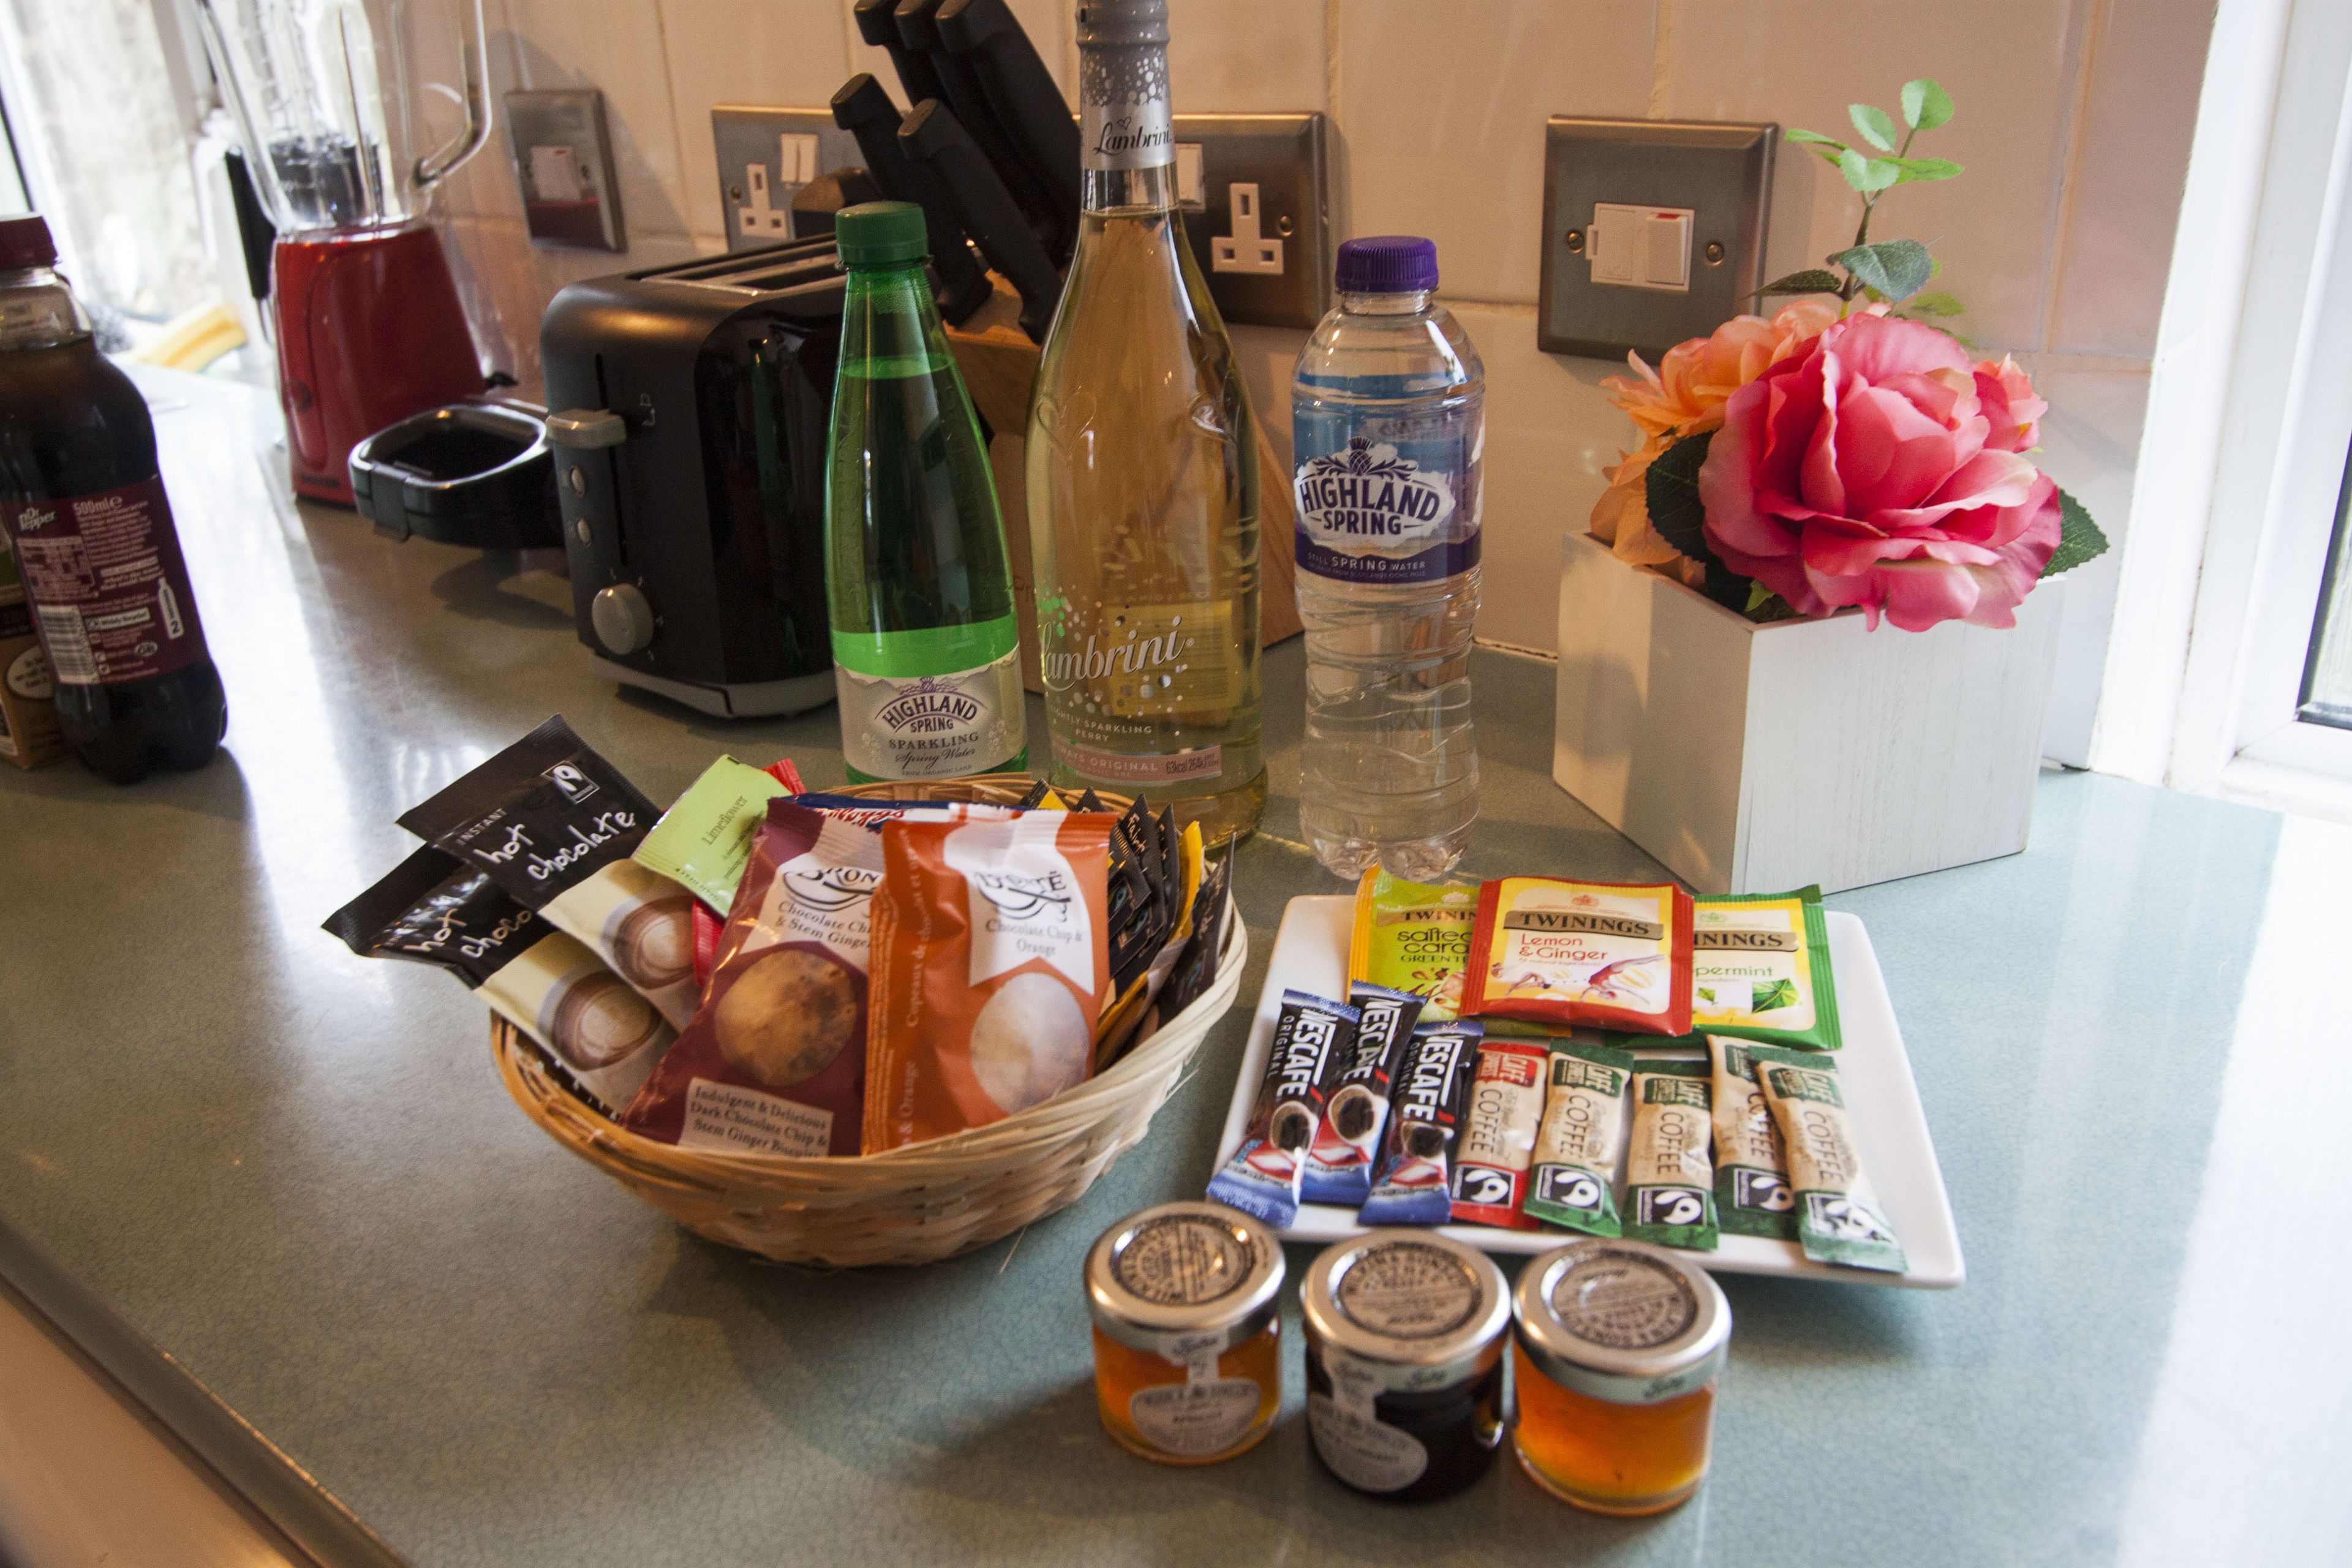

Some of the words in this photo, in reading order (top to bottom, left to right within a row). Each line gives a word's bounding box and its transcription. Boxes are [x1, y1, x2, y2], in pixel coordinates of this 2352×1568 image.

[1093, 122, 1170, 156] Lambrini
[1299, 477, 1441, 521] HIGHLAND
[1323, 510, 1402, 535] SPRING
[1332, 556, 1387, 571] SPRING
[1390, 561, 1426, 571] WATER
[882, 695, 979, 729] HIGHLAND
[911, 717, 954, 734] SPRING
[889, 731, 979, 750] SPARKLING
[1076, 728, 1109, 742] PERRY
[1085, 720, 1153, 734] SPARKLING
[895, 751, 946, 770] Spring
[943, 747, 976, 761] Water
[1090, 757, 1158, 772] ORIGINAL
[456, 807, 507, 846] INSTANT
[701, 795, 748, 846] Limeflower
[473, 823, 533, 864] hot
[527, 811, 636, 880] chocolate
[778, 900, 843, 929] Chocolate
[1520, 913, 1649, 935] TWININGS
[402, 908, 467, 952] hot
[787, 919, 823, 940] Stem
[1047, 925, 1072, 944] Chip
[1521, 933, 1583, 946] Lemon
[1694, 933, 1782, 947] ININGS
[1017, 938, 1056, 956] Orange
[1518, 947, 1533, 957] &
[1537, 946, 1608, 961] Ginger
[1695, 966, 1774, 977] permint
[1265, 1015, 1295, 1079] ORIGINAL
[1500, 1054, 1529, 1085] CAFÉ
[1585, 1065, 1615, 1093] CAFÉ
[694, 1086, 756, 1108] Indulgent
[770, 1104, 826, 1130] Delicious
[1471, 1088, 1502, 1153] COFFEE
[690, 1102, 720, 1118] Dark
[725, 1107, 781, 1134] Chocolate
[784, 1126, 814, 1147] Chip
[693, 1118, 725, 1137] Stem
[728, 1128, 767, 1148] Ginger
[1560, 1095, 1591, 1159] COFFEE
[1656, 1112, 1684, 1175] COFFEE
[1803, 1111, 1845, 1184] COFFEE
